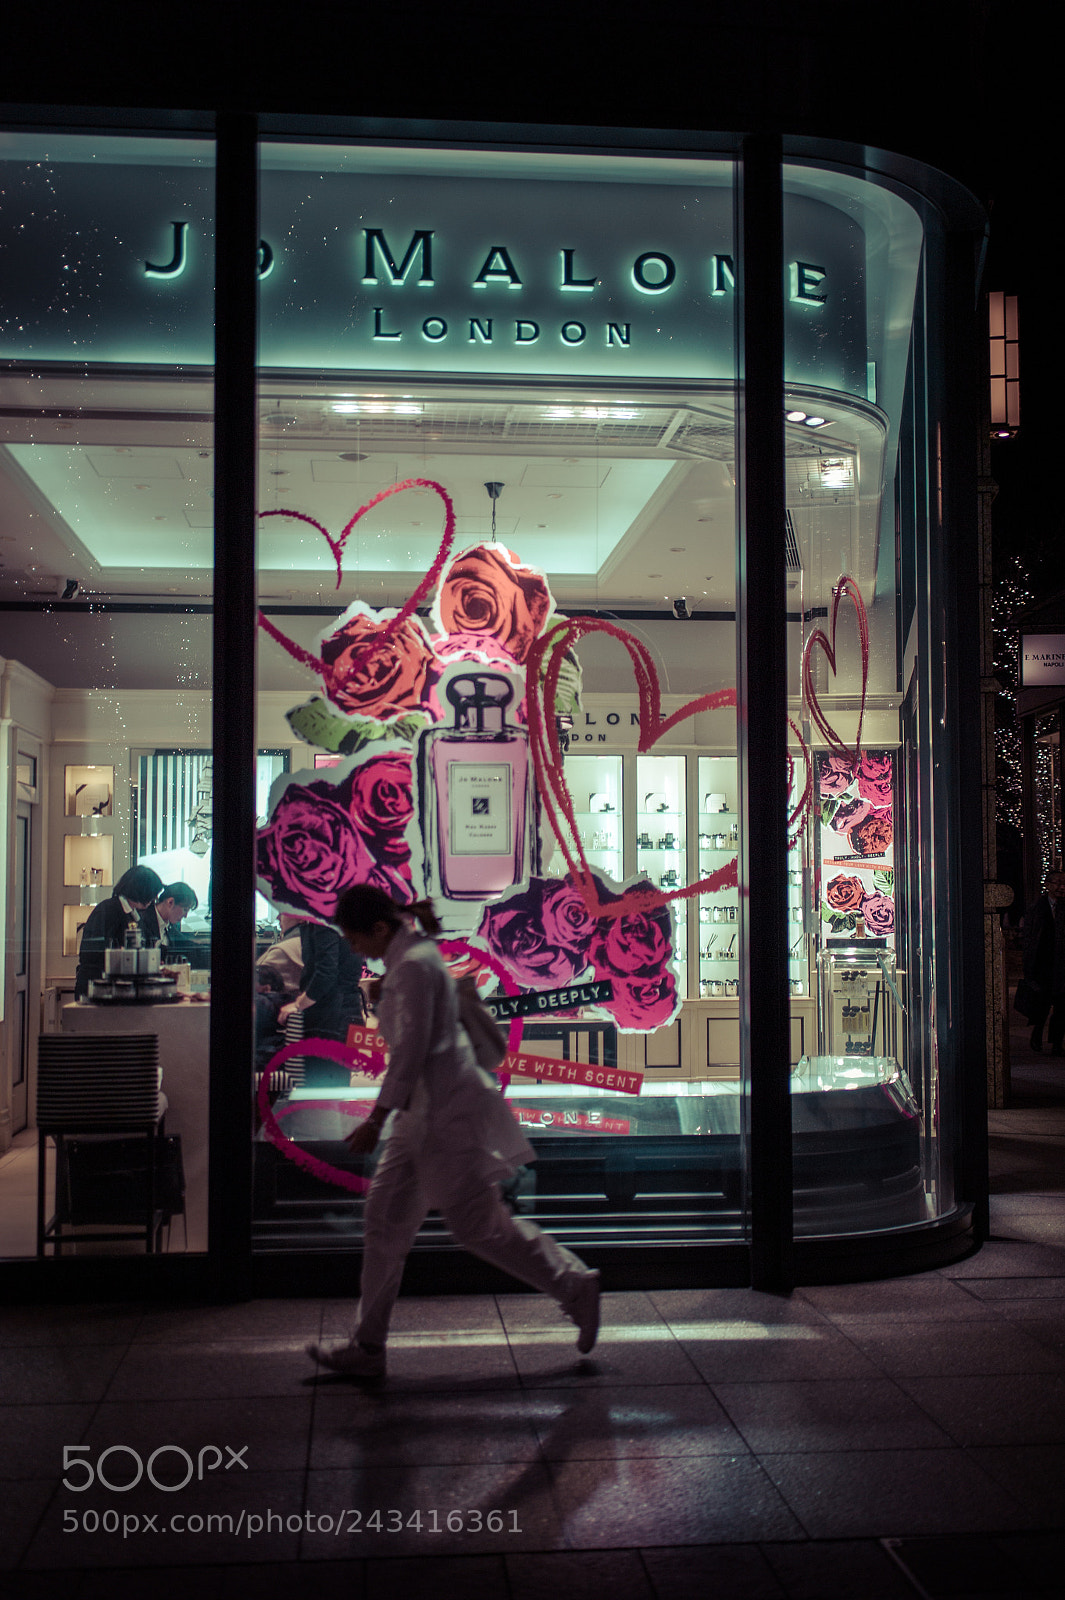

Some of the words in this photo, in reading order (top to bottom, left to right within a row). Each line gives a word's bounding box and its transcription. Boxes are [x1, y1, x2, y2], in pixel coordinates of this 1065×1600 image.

[371, 307, 632, 348] LONDON
[537, 985, 609, 1009] DEEPLY.
[500, 1056, 528, 1073] VE
[534, 1061, 578, 1081] WITH
[584, 1070, 638, 1090] SCENT
